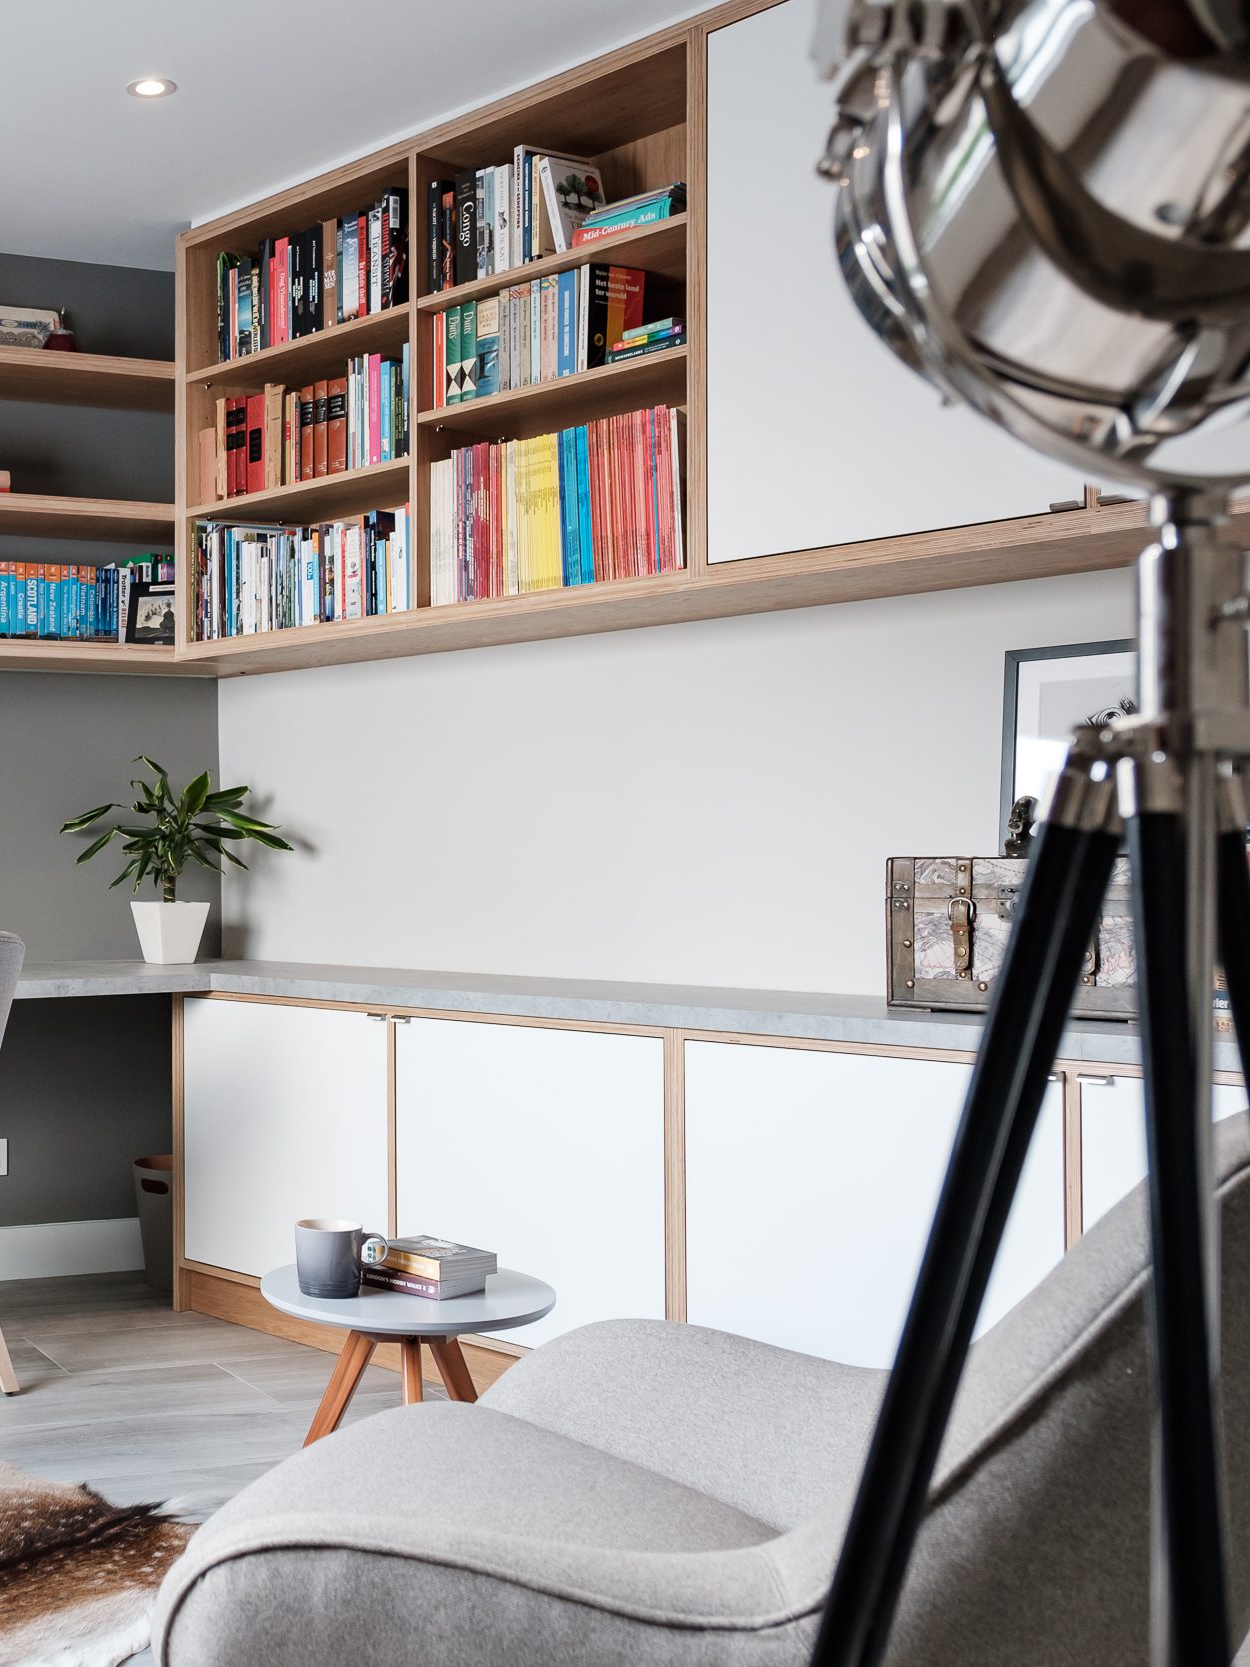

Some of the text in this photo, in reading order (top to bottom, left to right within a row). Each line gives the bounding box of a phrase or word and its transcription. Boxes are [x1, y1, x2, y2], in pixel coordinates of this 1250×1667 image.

[459, 201, 474, 246] Congo
[583, 219, 636, 241] Mid-Century
[638, 212, 656, 223] Ads
[372, 233, 380, 286] TRANSIT
[606, 292, 627, 300] wereld
[448, 317, 460, 339] Duits
[463, 311, 474, 335] Duits
[0, 581, 8, 623] Argentina
[27, 580, 37, 624] SCOTLAND
[72, 620, 76, 628] DC
[366, 1274, 389, 1282] LONDON'S
